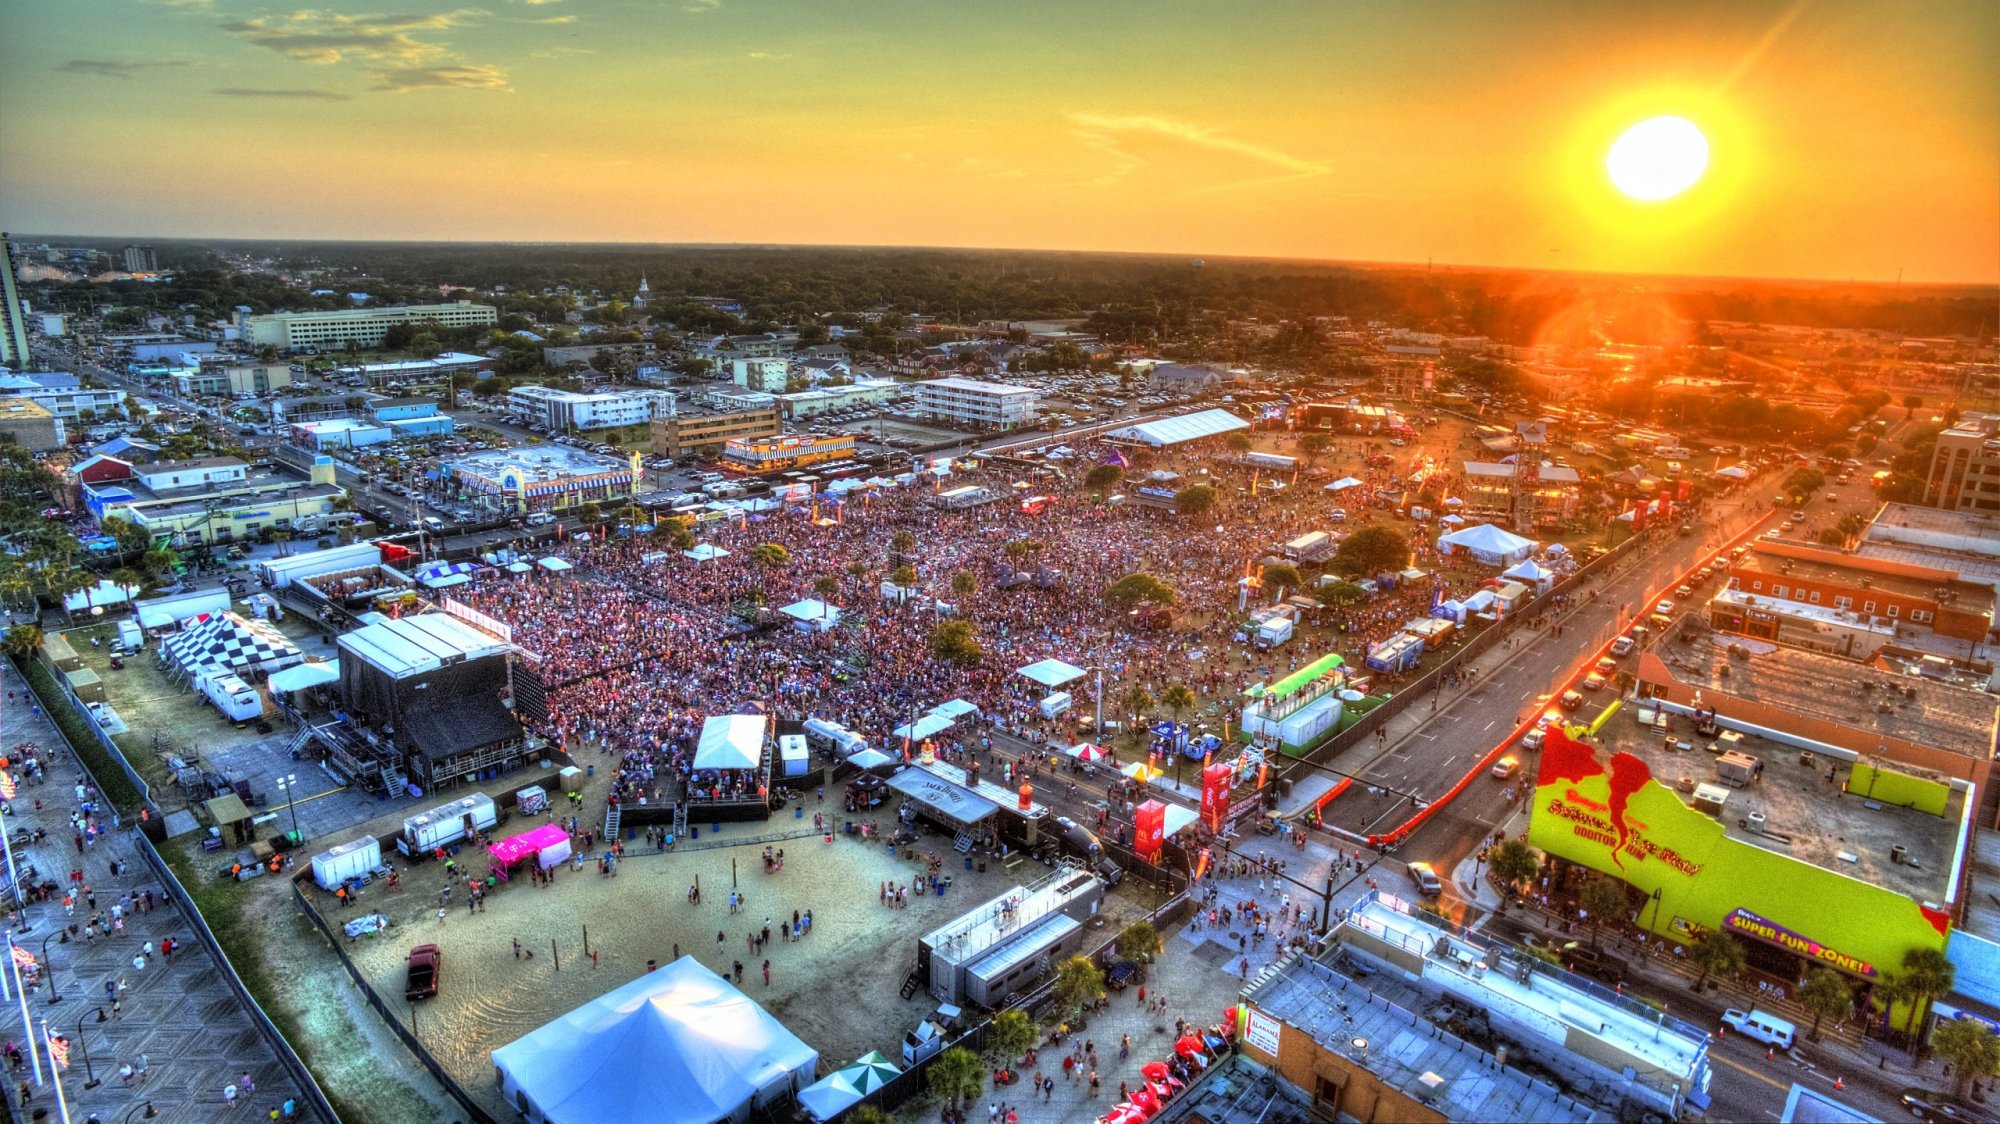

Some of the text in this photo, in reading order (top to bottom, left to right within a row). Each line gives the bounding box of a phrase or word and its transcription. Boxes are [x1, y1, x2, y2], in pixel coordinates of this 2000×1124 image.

[1733, 917, 1864, 972] SUPER FUN ZONE!
